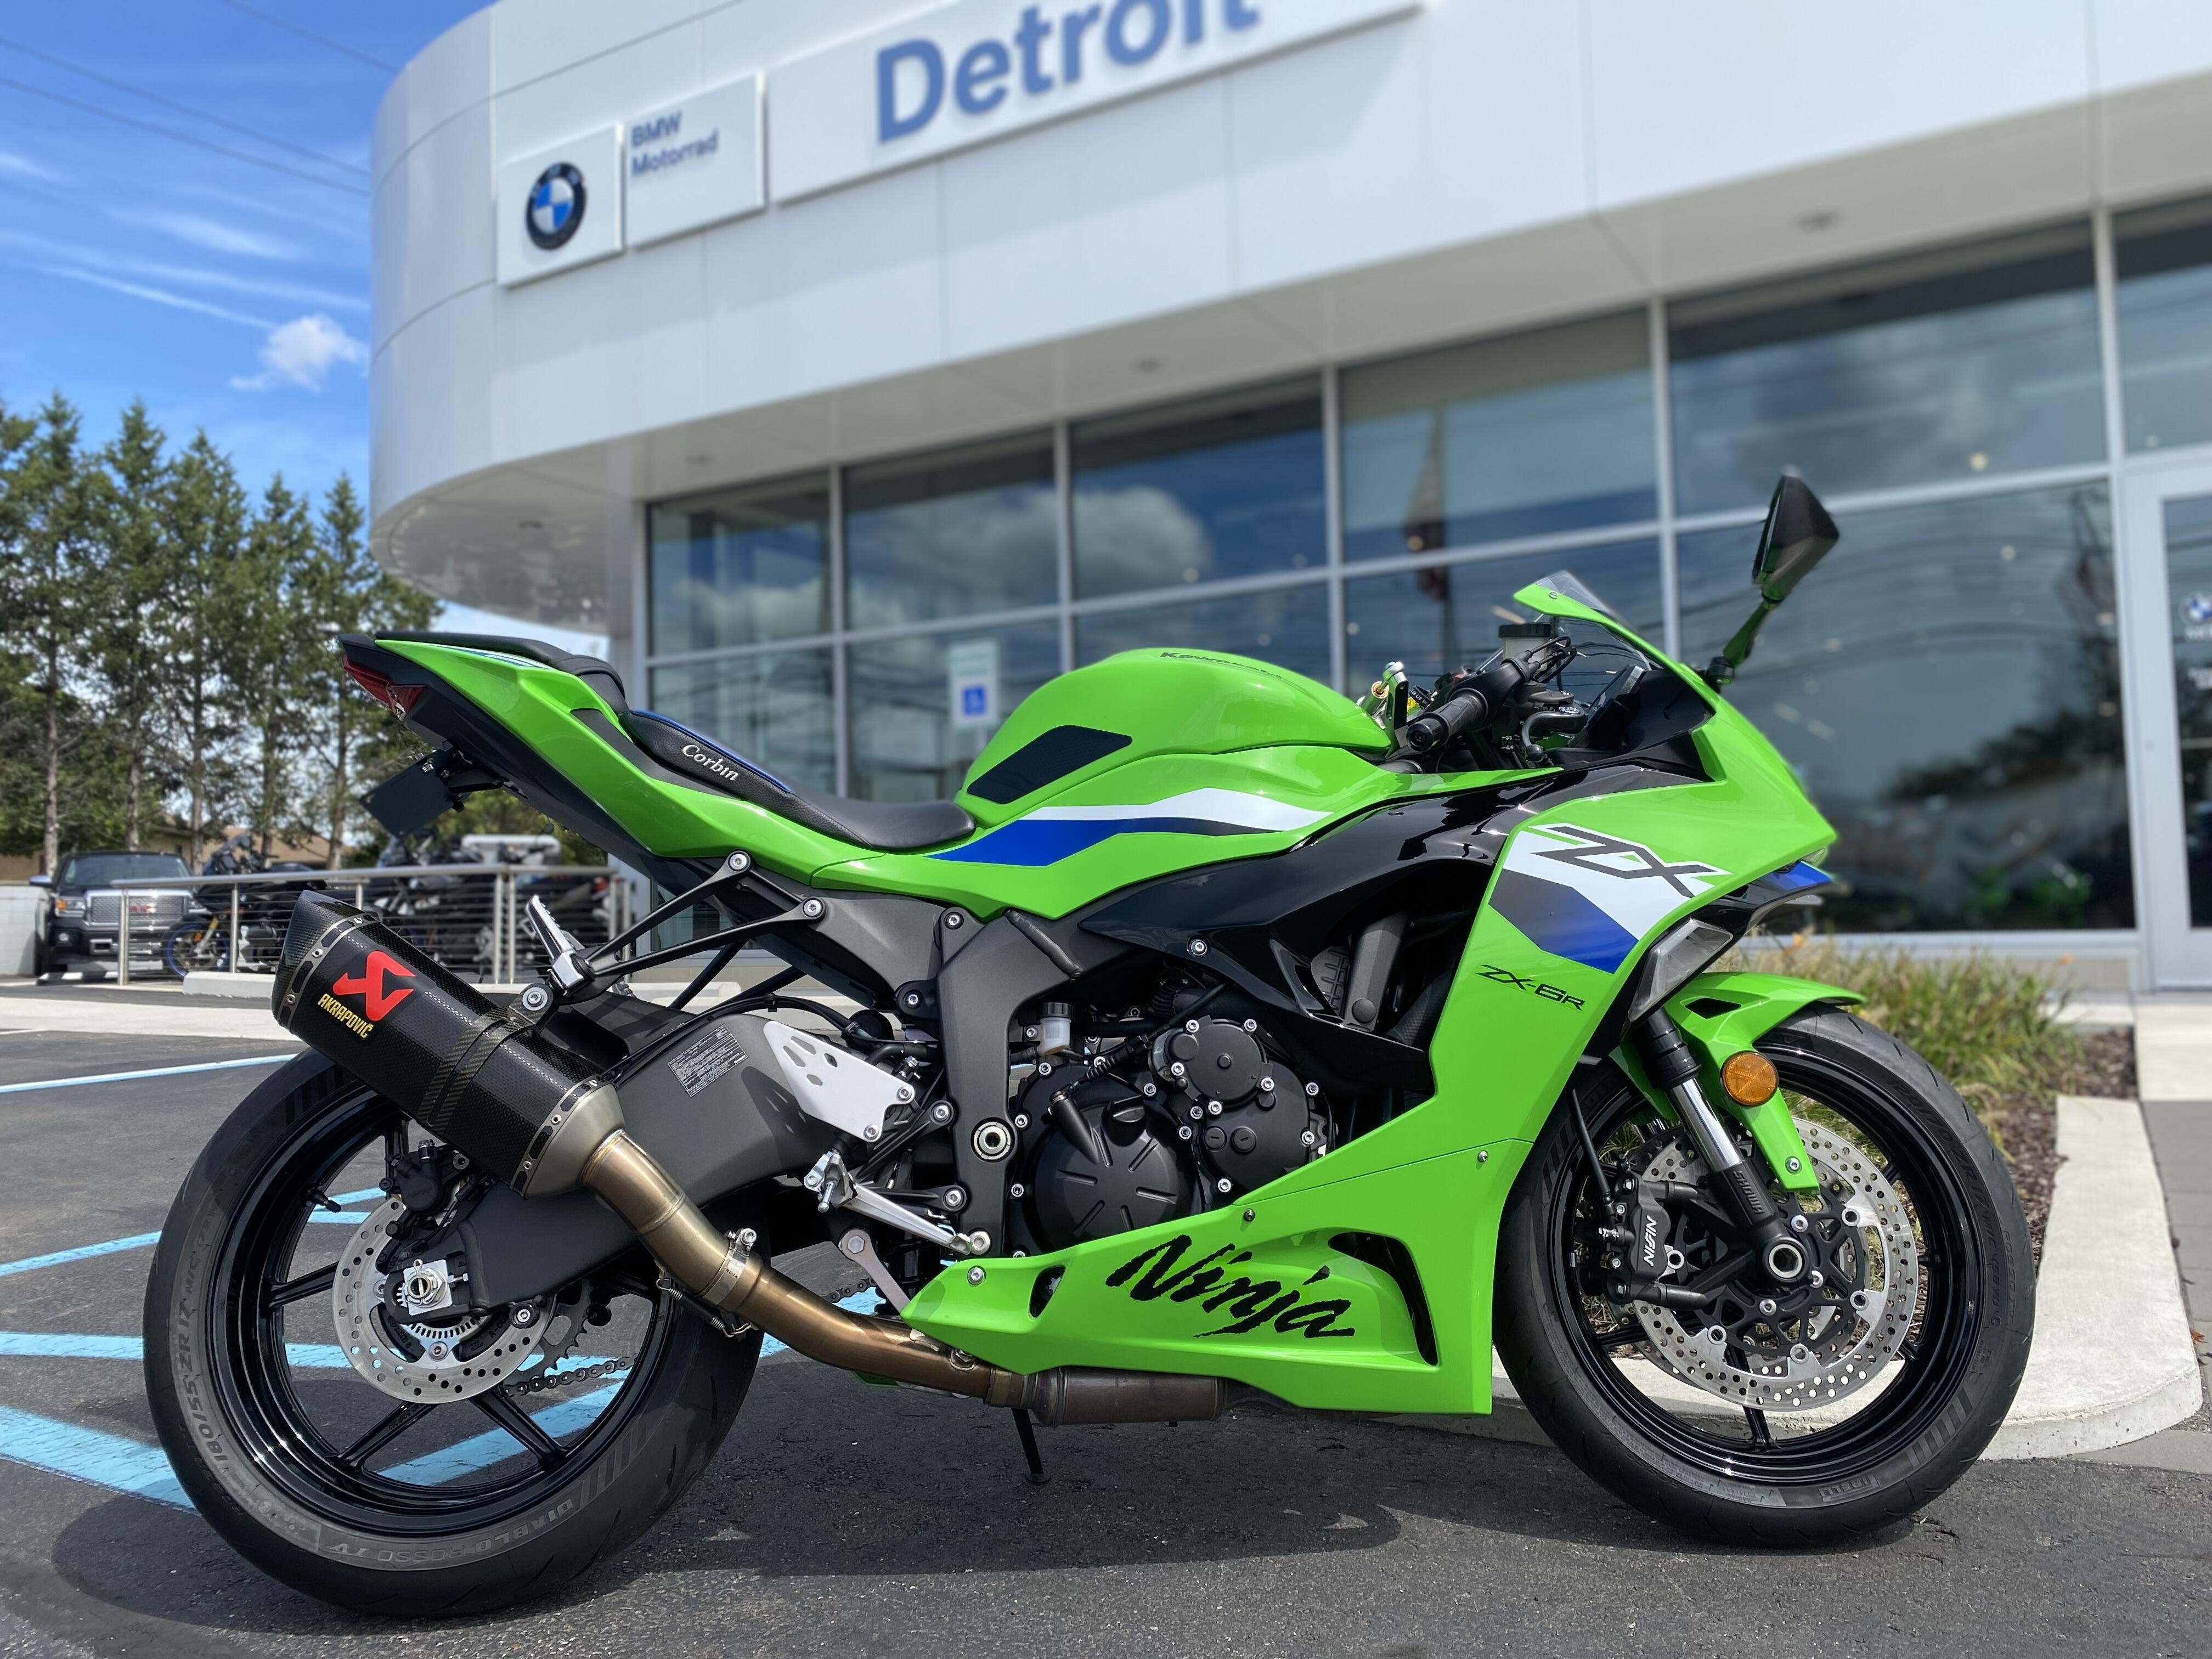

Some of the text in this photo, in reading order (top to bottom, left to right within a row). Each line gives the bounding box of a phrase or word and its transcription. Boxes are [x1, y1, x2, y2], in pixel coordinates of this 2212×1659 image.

[632, 111, 682, 146] BMW
[631, 129, 719, 176] Motorrad
[682, 744, 739, 781] Corbin
[1530, 824, 1724, 898] ZX
[1475, 964, 1585, 1011] ZX-6R
[1733, 1170, 1765, 1215] SHOWA
[1105, 1234, 1355, 1339] Ninja
[178, 1333, 192, 1374] ZR
[184, 1380, 228, 1463] 180/55
[1818, 1474, 1880, 1502] PIRELLI
[325, 1498, 574, 1563] DIABLO ROSSO IV
